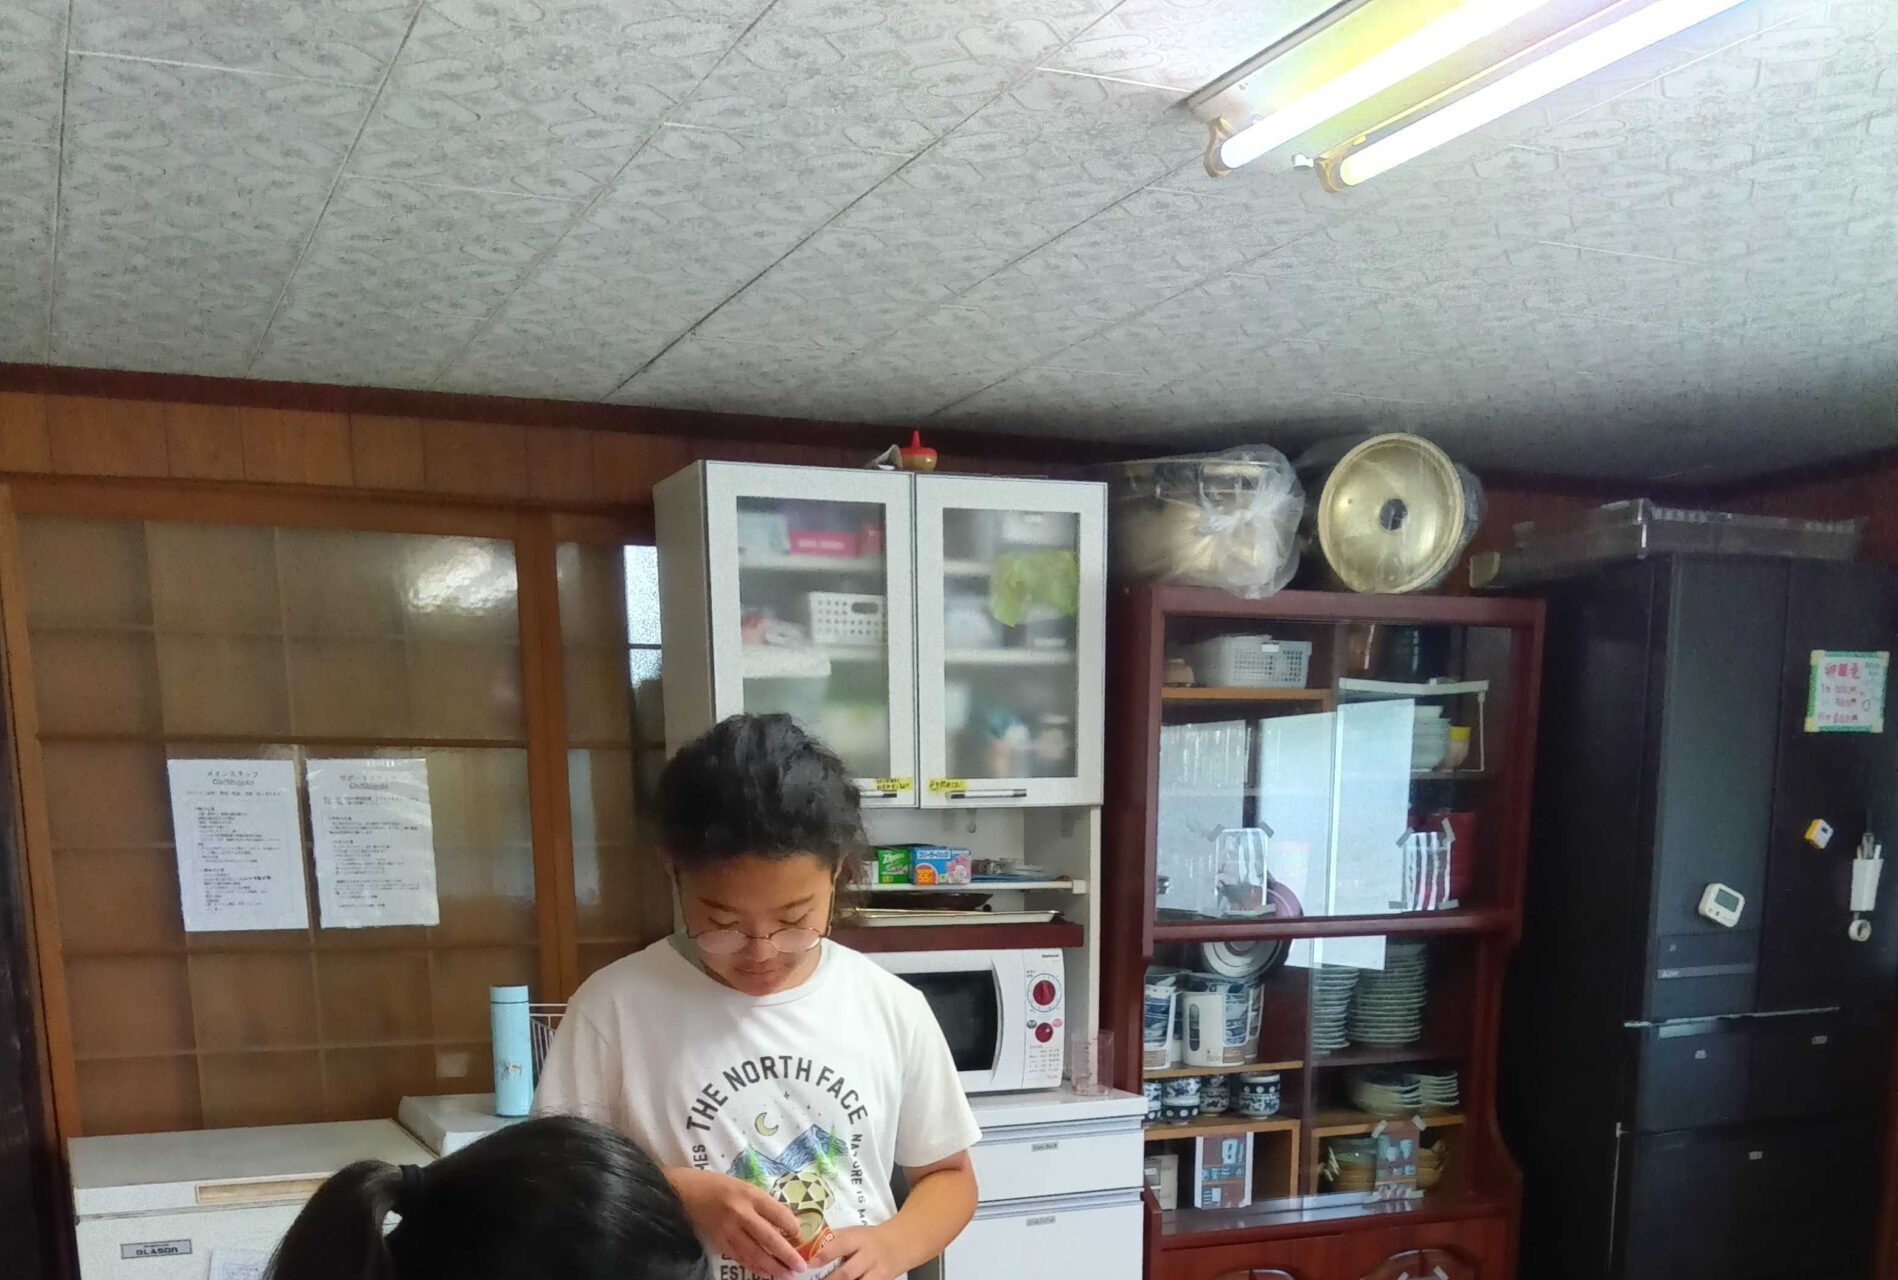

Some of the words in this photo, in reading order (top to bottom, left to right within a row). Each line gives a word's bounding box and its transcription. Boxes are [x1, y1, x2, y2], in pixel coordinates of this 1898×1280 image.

[686, 1082, 729, 1132] THE
[722, 1055, 813, 1092] NORTH
[815, 1065, 869, 1126] FACE
